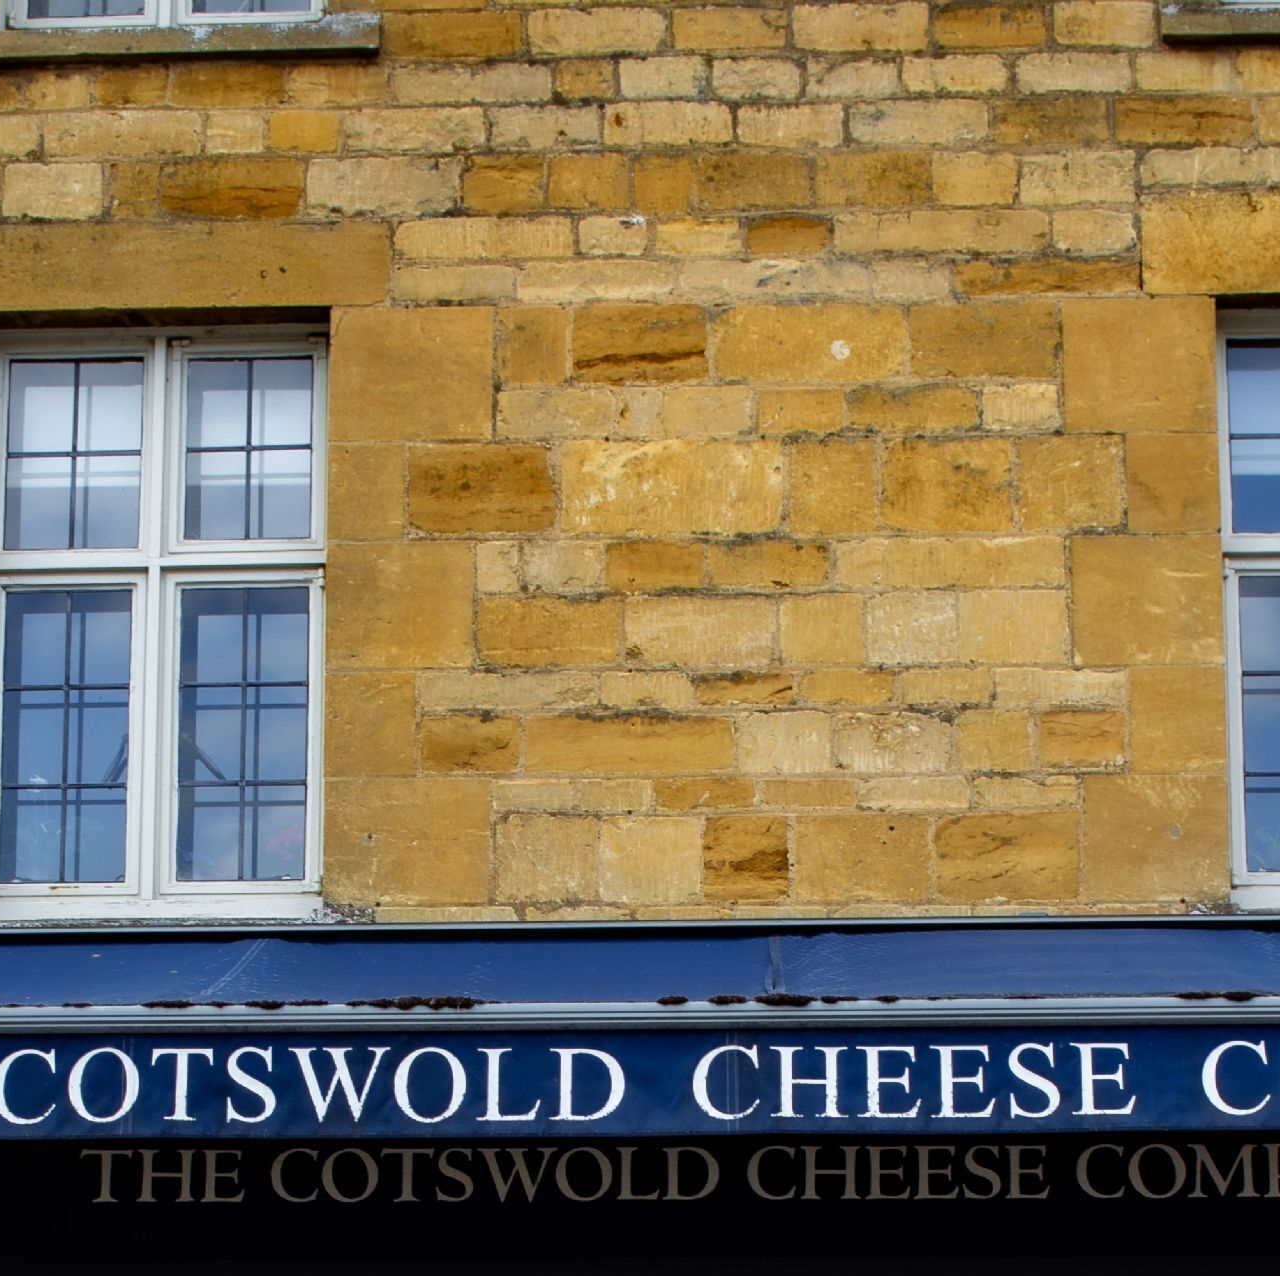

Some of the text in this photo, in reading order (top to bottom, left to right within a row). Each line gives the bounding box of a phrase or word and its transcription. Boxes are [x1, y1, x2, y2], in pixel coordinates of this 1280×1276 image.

[692, 1042, 1137, 1121] CHEESE
[81, 1149, 245, 1204] THE
[271, 1147, 720, 1203] COTSWOLD
[747, 1145, 1050, 1201] CHEESE
